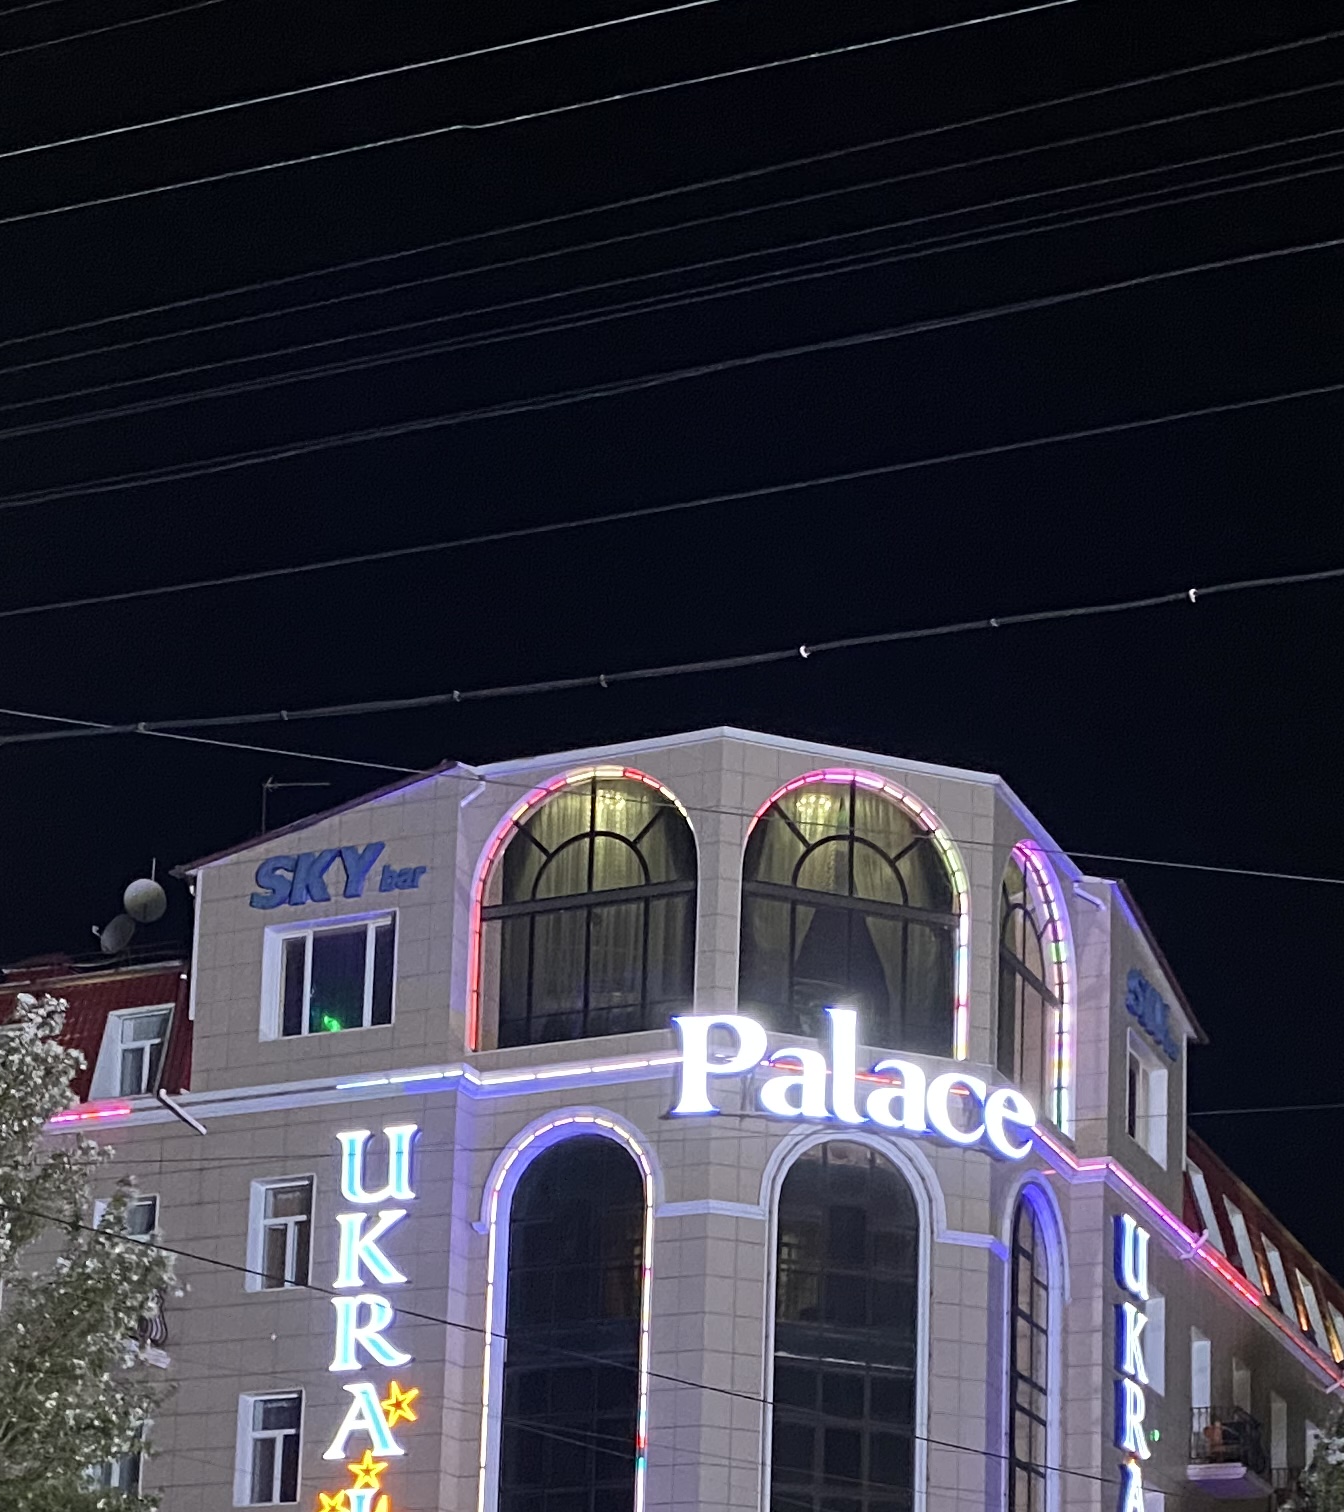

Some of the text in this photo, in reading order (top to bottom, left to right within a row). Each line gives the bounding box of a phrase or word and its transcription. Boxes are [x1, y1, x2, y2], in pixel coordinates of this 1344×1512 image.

[250, 841, 427, 910] SKY bar
[671, 1005, 1037, 1159] Palace
